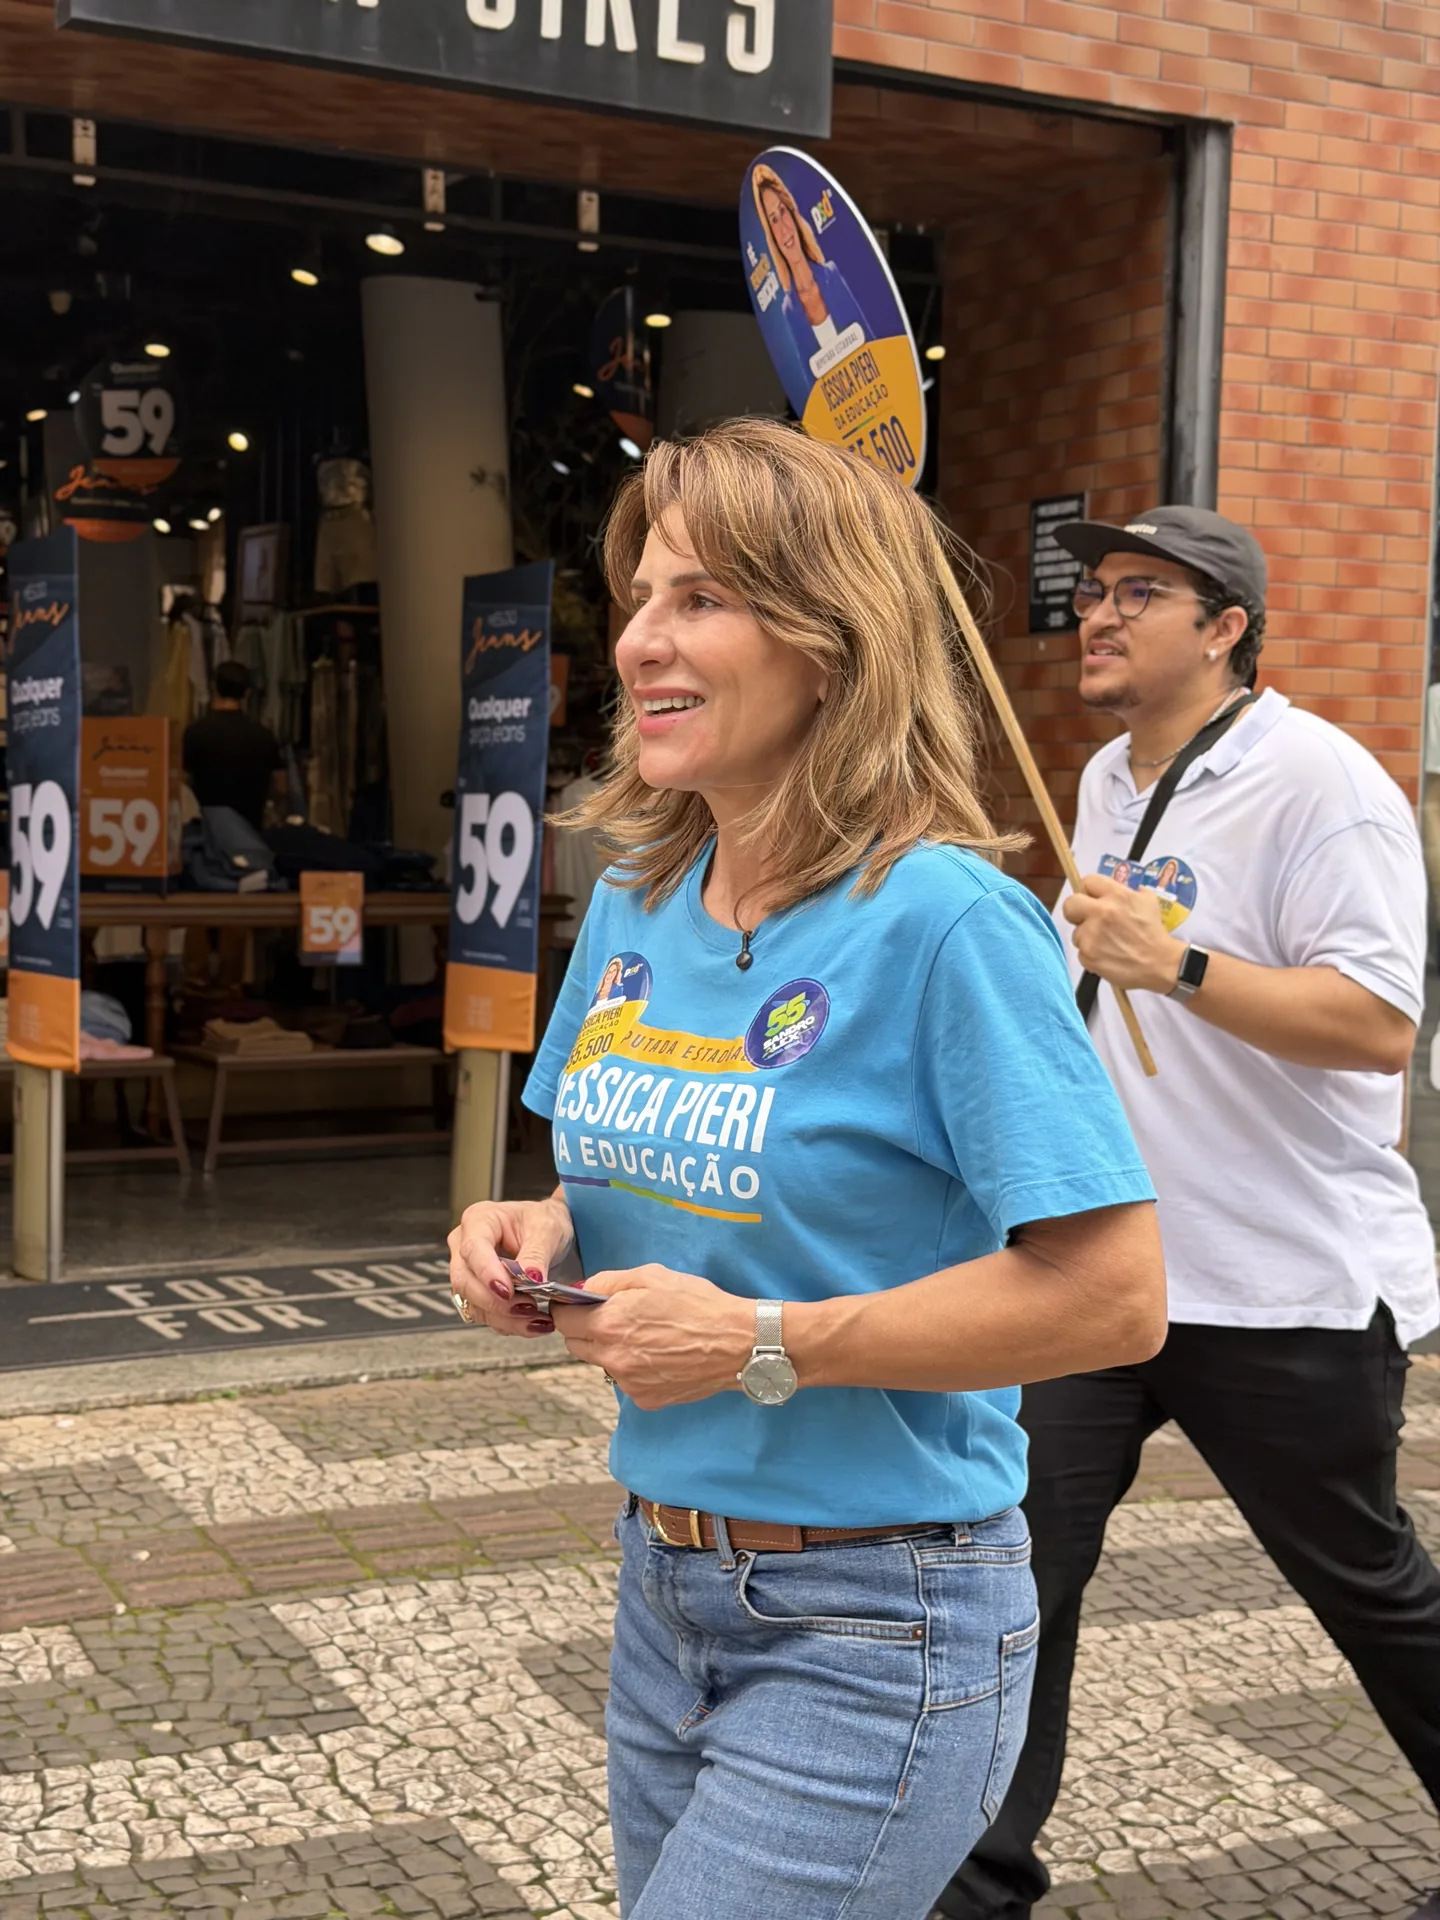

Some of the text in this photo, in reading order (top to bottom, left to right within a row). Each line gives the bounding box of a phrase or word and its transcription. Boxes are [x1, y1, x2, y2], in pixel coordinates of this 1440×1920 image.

[849, 348, 881, 391] PIERI
[101, 388, 175, 456] 59
[834, 384, 889, 431] DA EDUCAÇÃO
[468, 695, 533, 723] Qualquer
[549, 684, 562, 717] 9
[88, 797, 161, 867] 59
[10, 780, 71, 930] 59
[456, 791, 534, 929] 59
[309, 905, 358, 945] 59
[602, 1006, 624, 1023] PIERI
[763, 1015, 815, 1050] SANDRO
[764, 991, 807, 1037] 55
[620, 1030, 679, 1055] PUTADA
[554, 1061, 776, 1154] ESSICA PIERI
[553, 1131, 760, 1199] A EDUCAÇÃO
[105, 1276, 284, 1308] FOR
[136, 1305, 328, 1341] FOR
